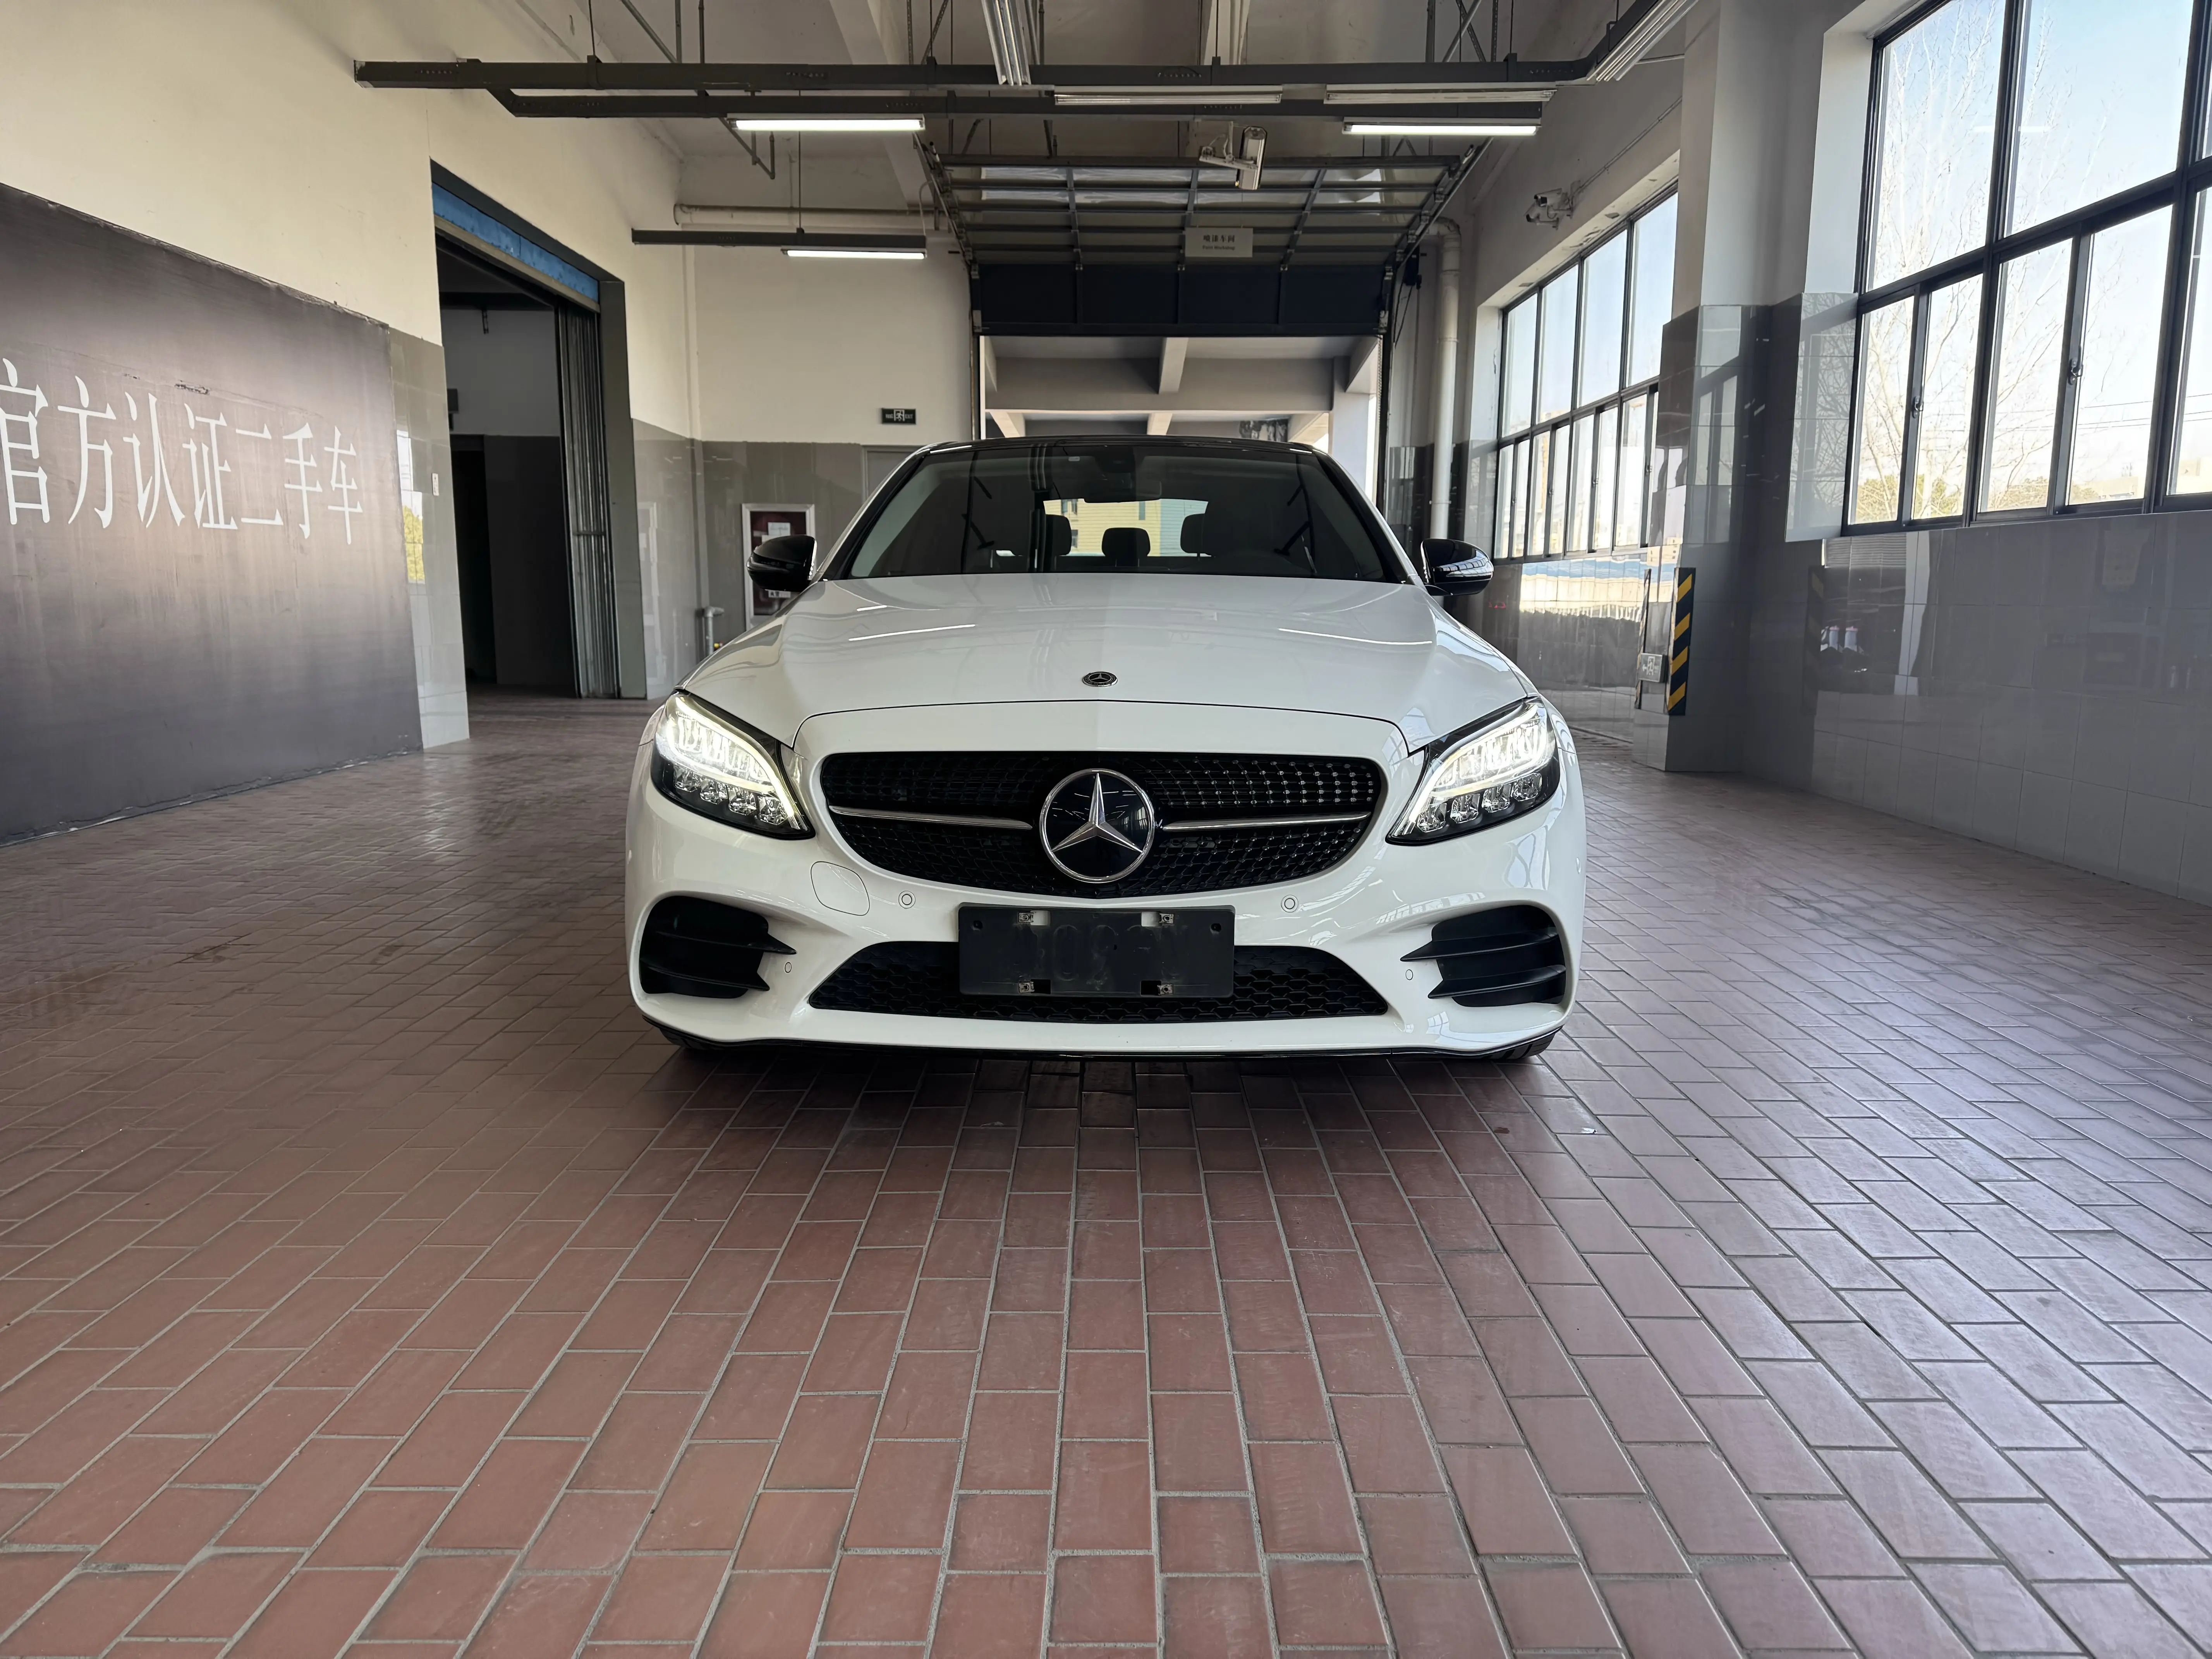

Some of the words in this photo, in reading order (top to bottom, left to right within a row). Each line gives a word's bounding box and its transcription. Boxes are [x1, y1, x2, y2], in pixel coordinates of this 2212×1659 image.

[1203, 234, 1235, 243] 喷漆车间
[0, 358, 363, 544] 官方认证二手车
